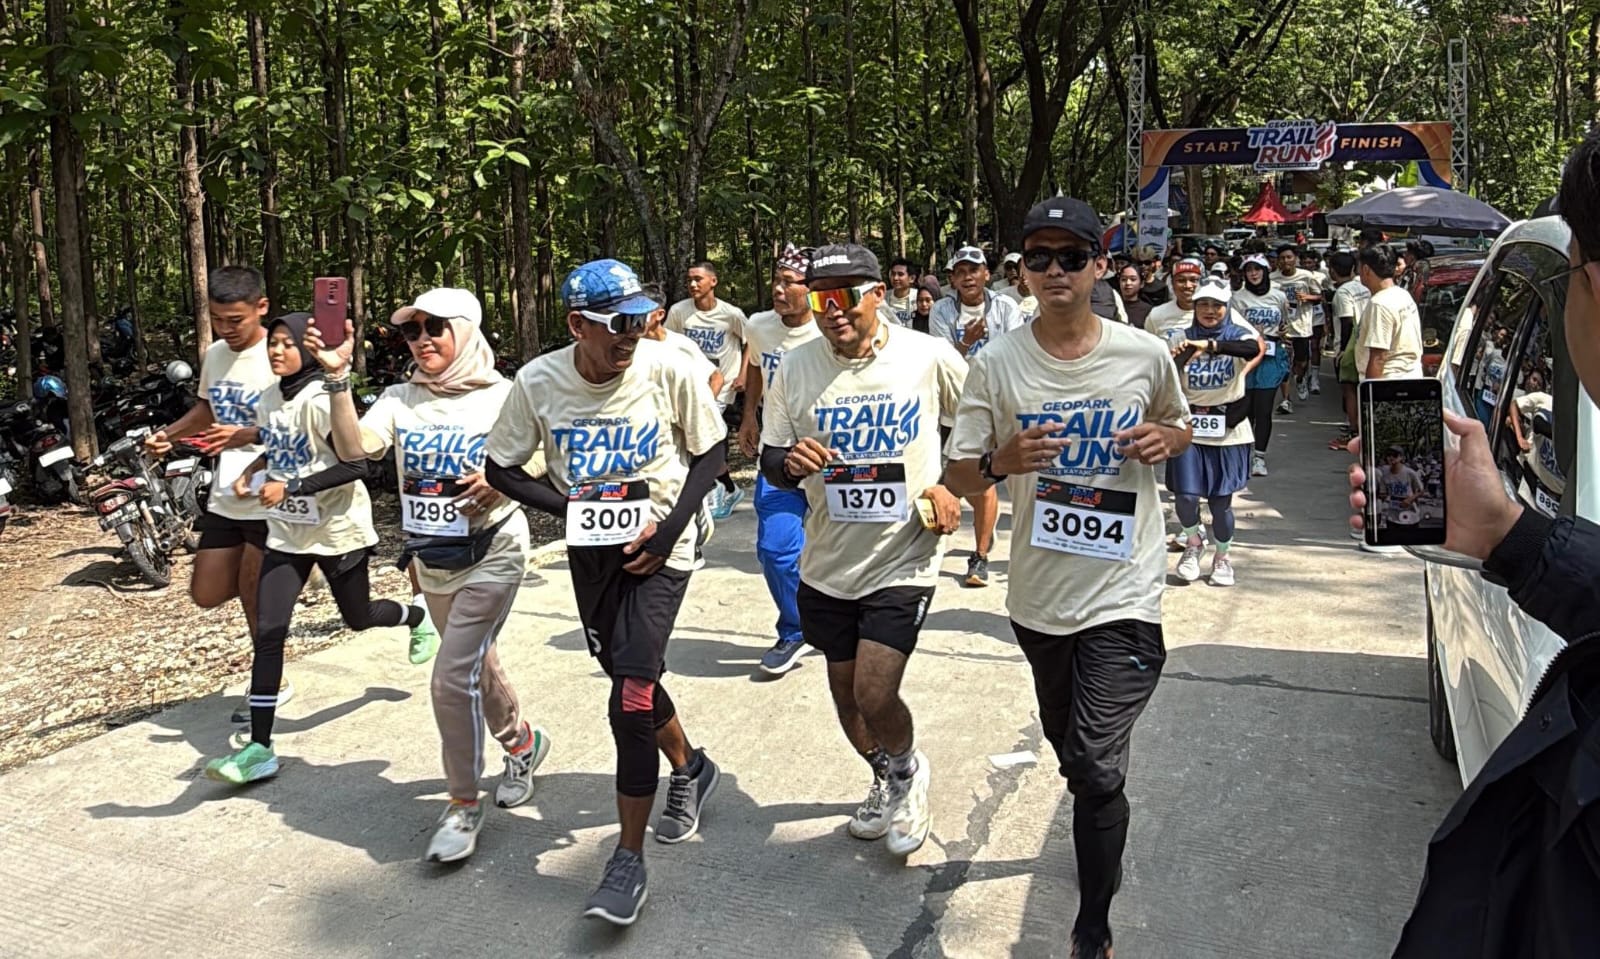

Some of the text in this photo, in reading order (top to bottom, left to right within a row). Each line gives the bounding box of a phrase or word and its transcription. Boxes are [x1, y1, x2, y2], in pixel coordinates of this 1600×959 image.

[1183, 141, 1241, 153] START
[1249, 128, 1316, 145] TRAIL
[1340, 136, 1403, 150] FINISH
[1259, 145, 1315, 163] RUN
[684, 328, 717, 341] TRAIL
[1188, 358, 1225, 375] RAIL
[1188, 374, 1224, 387] RUN
[835, 393, 893, 405] GEOPARK
[1042, 399, 1113, 412] GEOPARK
[572, 417, 631, 427] GEOPARK
[815, 403, 899, 431] TRAIL
[396, 427, 467, 453] TRAIL
[551, 426, 636, 453] TRAIL
[830, 427, 898, 453] RUN
[404, 452, 464, 476] RUN
[1050, 440, 1114, 467] UN
[568, 452, 636, 480] RUN
[838, 488, 896, 509] 1370
[408, 500, 457, 523] 1298
[580, 507, 641, 530] 3001
[1042, 508, 1125, 544] 3094
